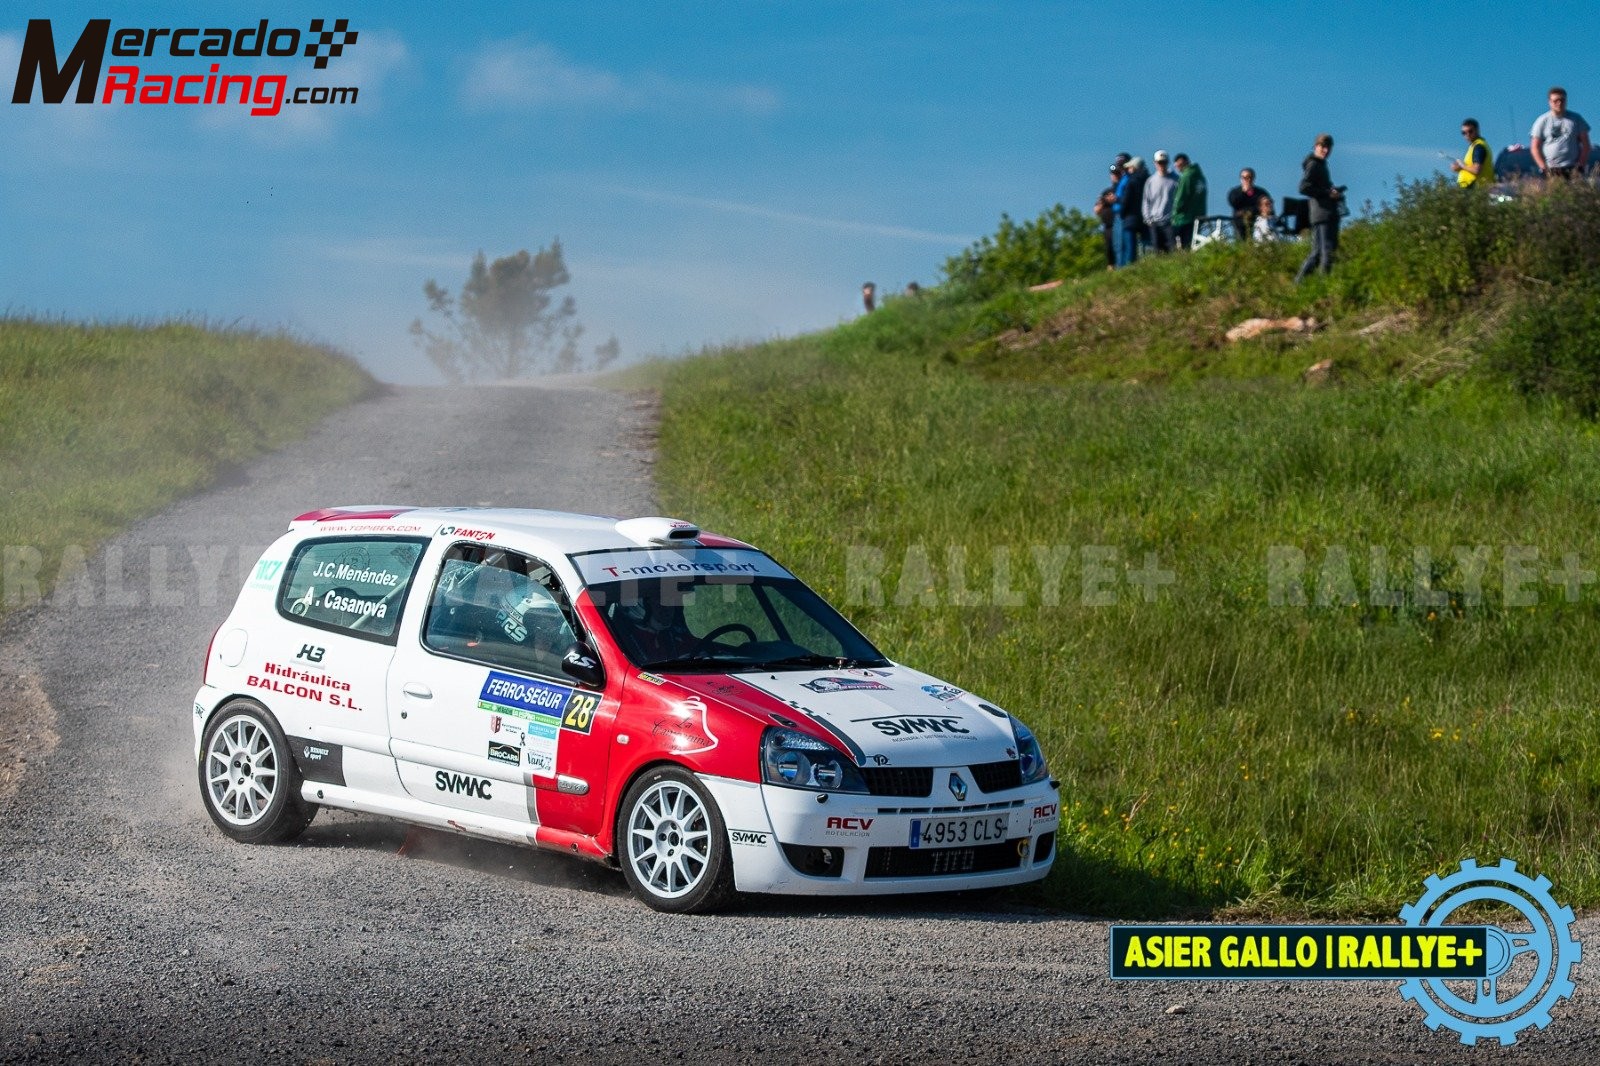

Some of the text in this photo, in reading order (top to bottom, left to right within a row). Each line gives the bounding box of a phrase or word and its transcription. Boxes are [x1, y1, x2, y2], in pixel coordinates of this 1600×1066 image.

[602, 562, 760, 577] T-motorsport
[324, 590, 388, 619] Casanova
[264, 662, 351, 692] Hidráulica
[246, 675, 363, 711] BALCON S.L.
[565, 694, 595, 729] 28
[872, 717, 970, 736] SVMAC
[435, 770, 492, 800] SVMAC
[826, 816, 874, 831] ACV
[1033, 803, 1057, 818] ACV
[732, 831, 767, 844] SVMAC
[921, 818, 1003, 844] 4953 CLS
